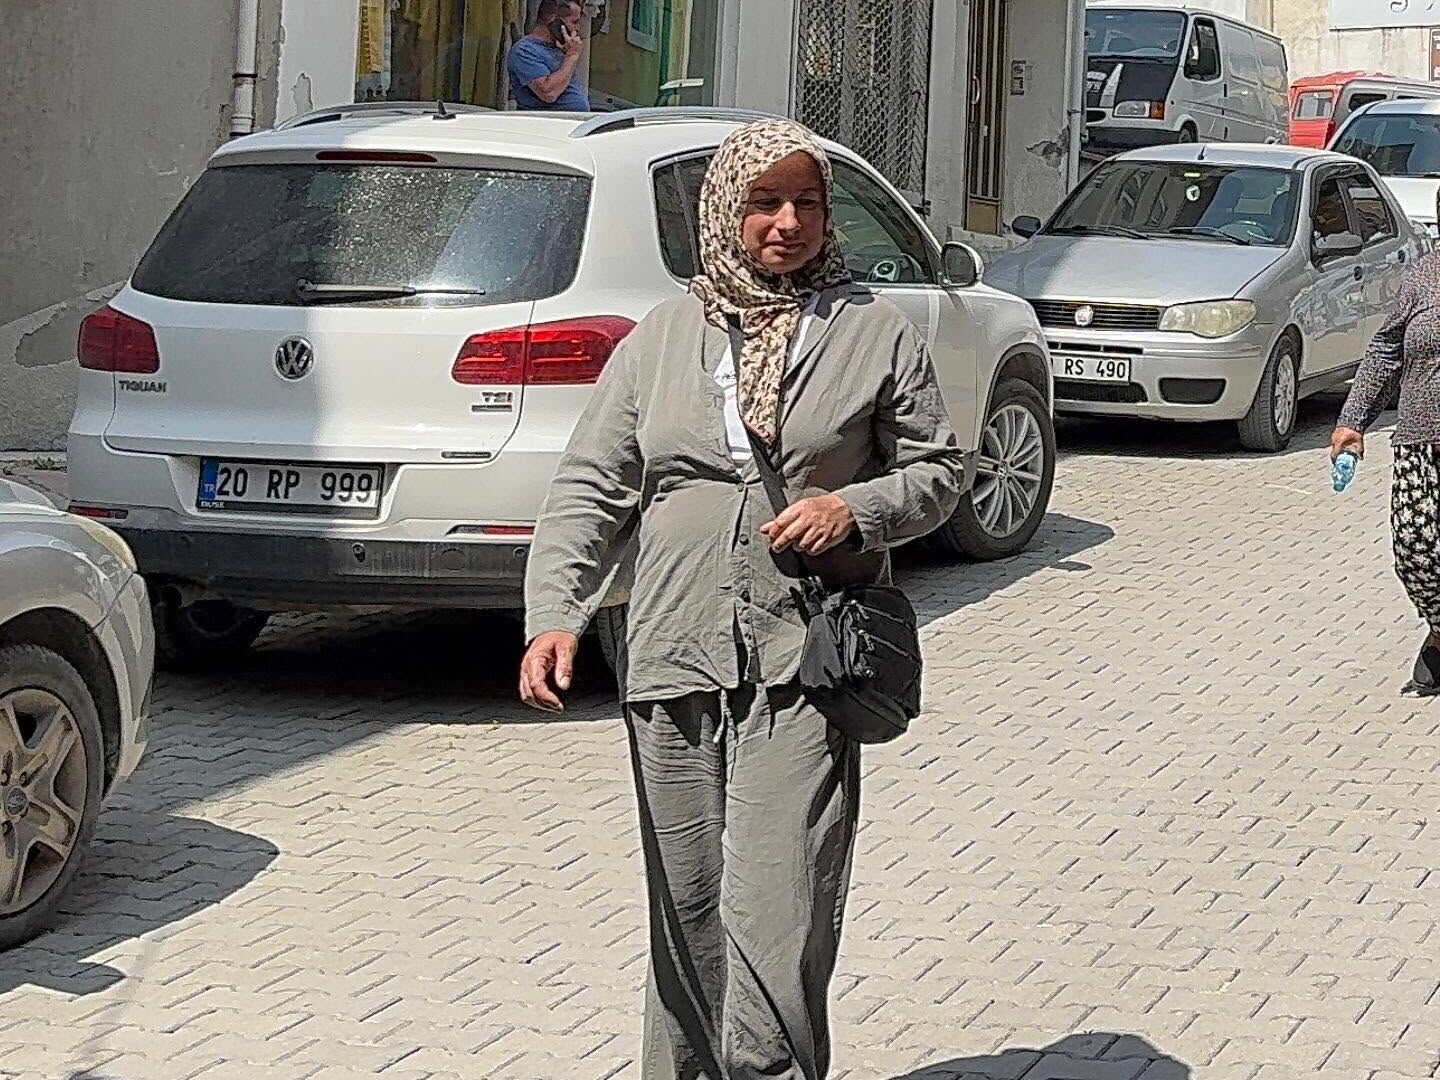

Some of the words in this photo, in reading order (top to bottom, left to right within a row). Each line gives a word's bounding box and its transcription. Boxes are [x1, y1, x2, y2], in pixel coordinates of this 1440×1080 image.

[1064, 358, 1084, 376] RS
[1096, 361, 1126, 379] 490
[203, 483, 216, 493] TR
[216, 467, 249, 498] 20
[266, 469, 300, 500] RP
[320, 472, 373, 503] 999
